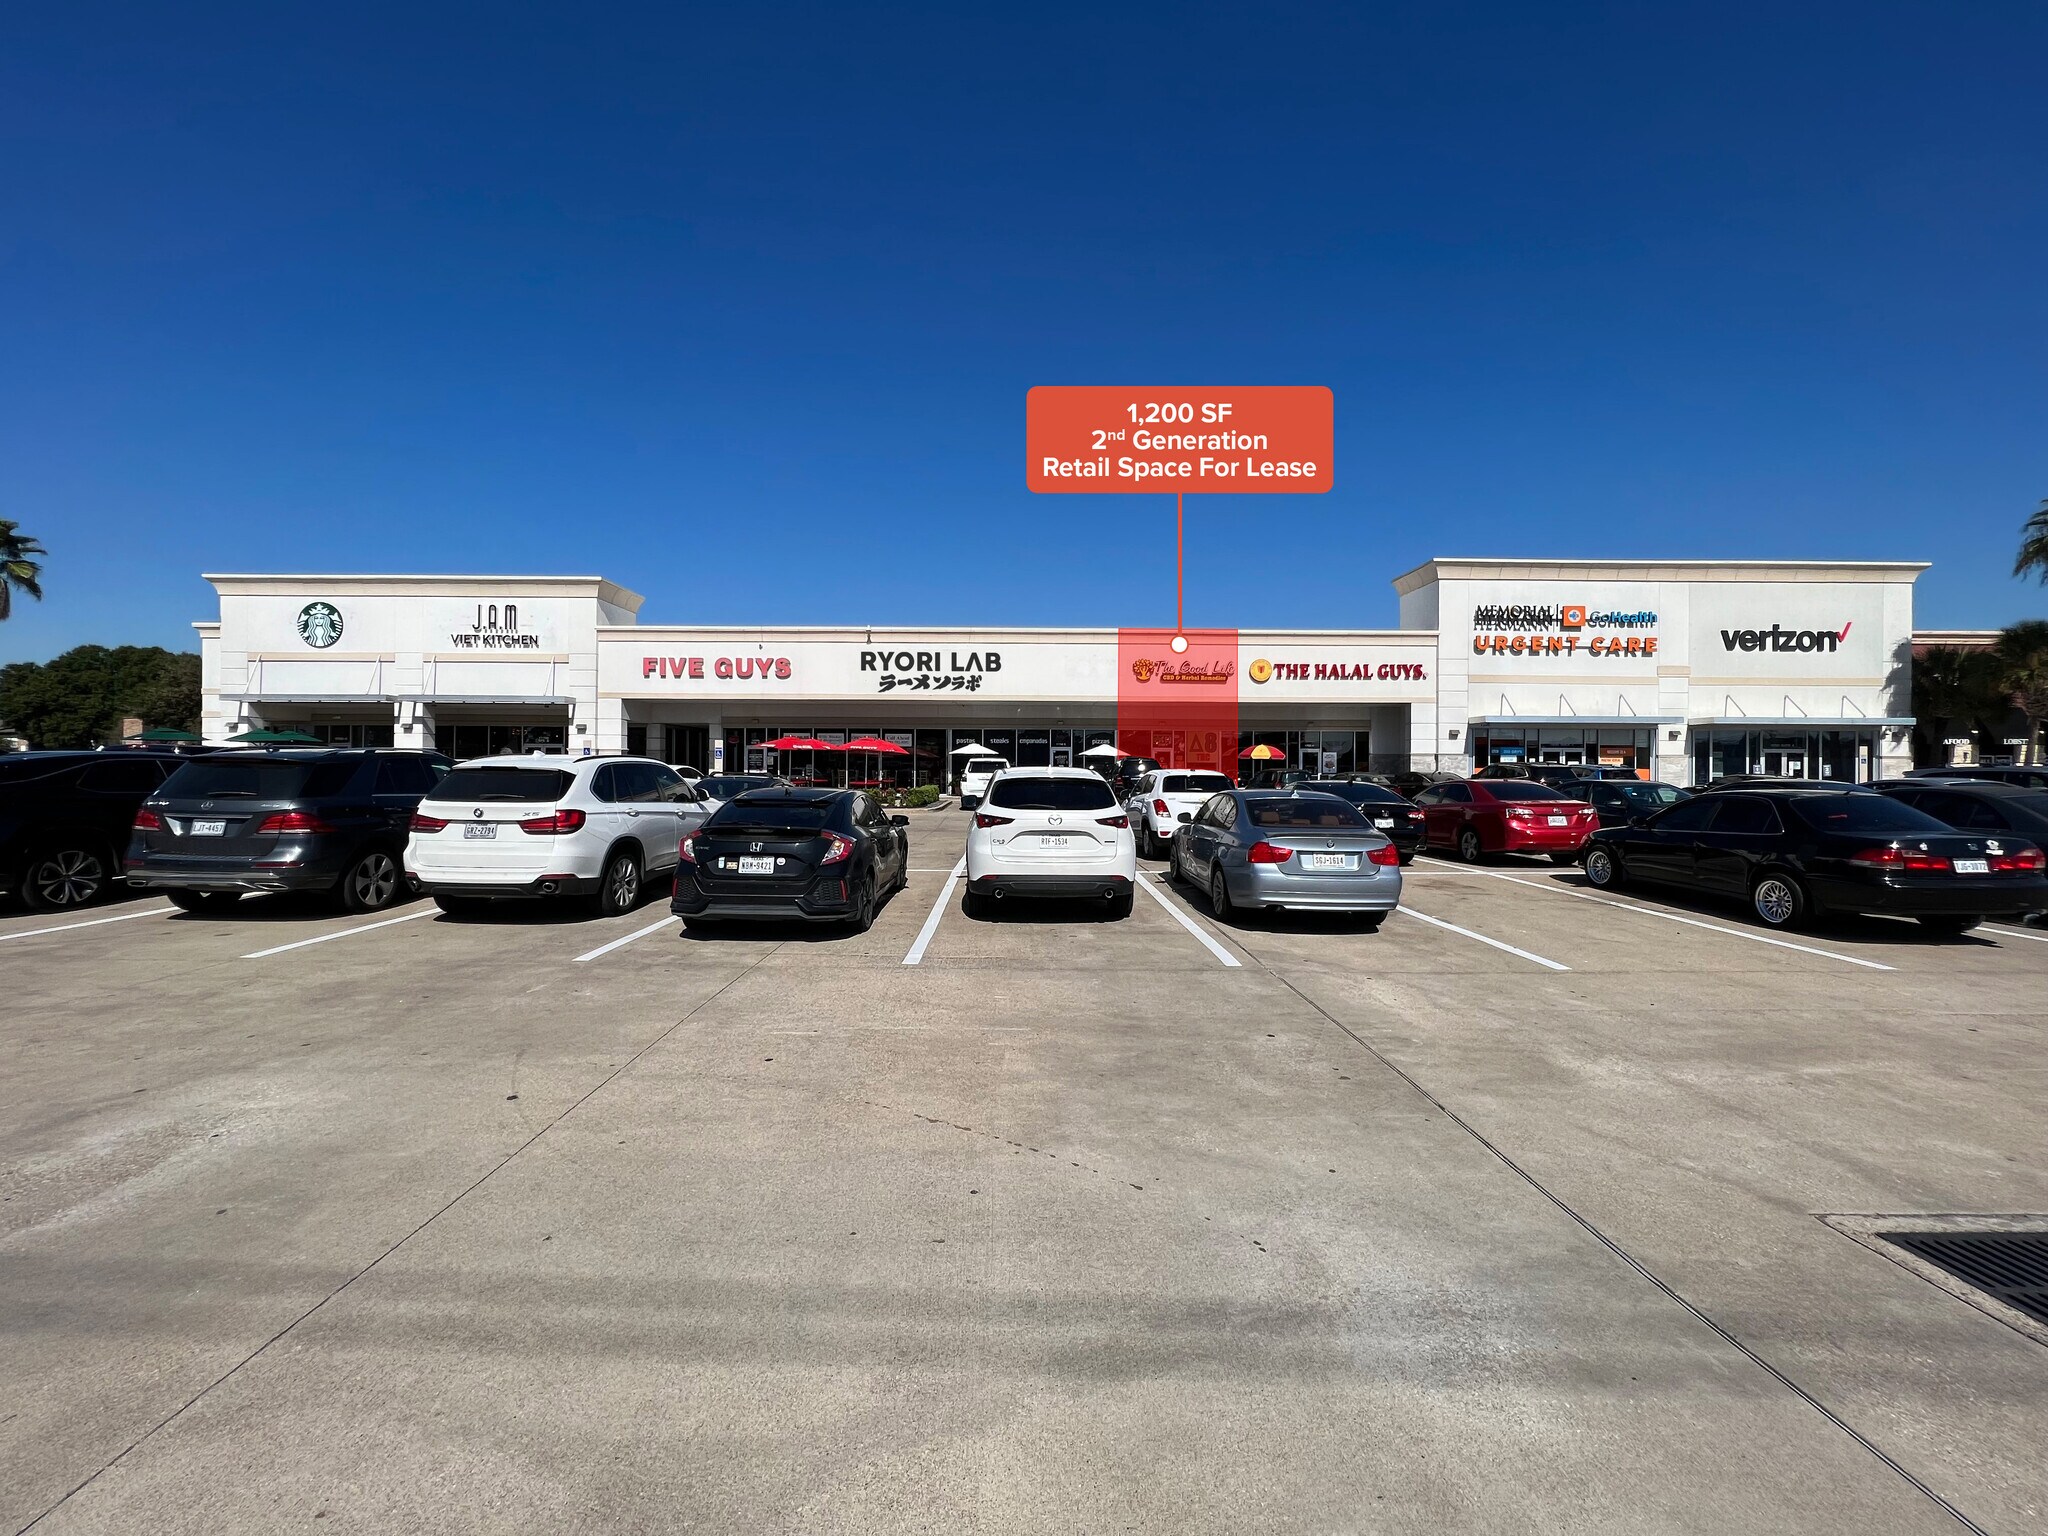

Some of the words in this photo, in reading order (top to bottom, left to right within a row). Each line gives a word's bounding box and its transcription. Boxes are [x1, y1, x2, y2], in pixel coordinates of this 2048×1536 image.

[1477, 604, 1554, 618] MEMORIAL
[1590, 610, 1658, 624] GoHealth
[451, 634, 480, 645] VIET
[483, 634, 539, 646] KITCHEN
[1476, 636, 1580, 652] URGENT
[1592, 637, 1658, 652] CARE
[1721, 624, 1838, 652] verizon
[642, 657, 705, 677] FIVE
[714, 657, 792, 679] GUYS
[860, 651, 941, 671] RYORI
[951, 652, 1002, 672] LAB
[1154, 660, 1175, 673] The
[1179, 660, 1209, 674] Good
[1212, 660, 1235, 674] Life
[1273, 664, 1310, 679] THE
[1314, 664, 1373, 679] HALAL
